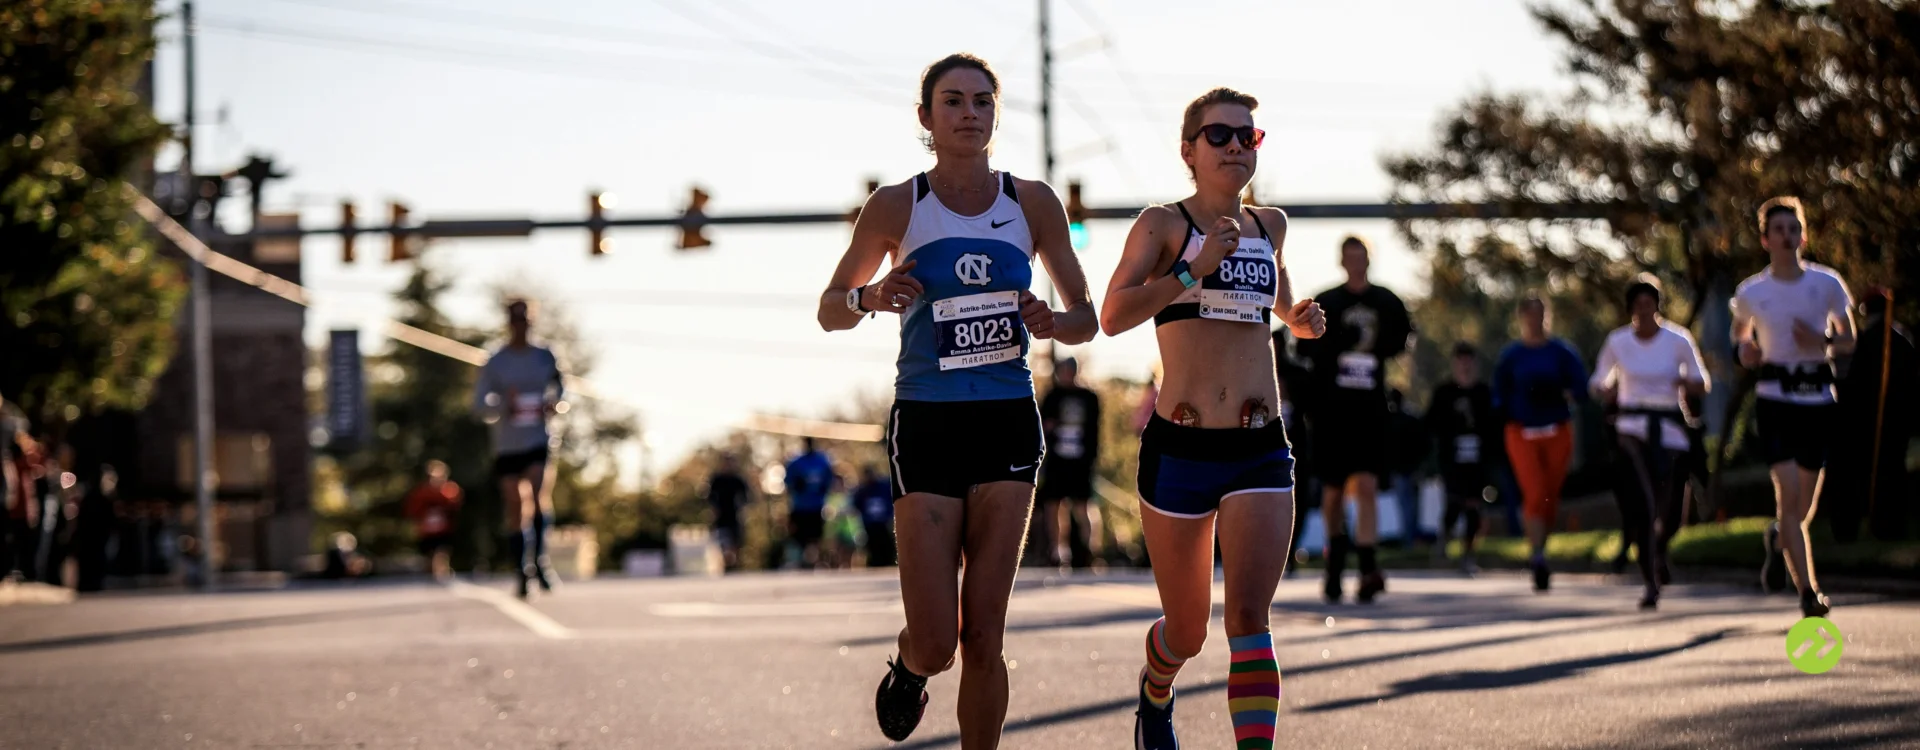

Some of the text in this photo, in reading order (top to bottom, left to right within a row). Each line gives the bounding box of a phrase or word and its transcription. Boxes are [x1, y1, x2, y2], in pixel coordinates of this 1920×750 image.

[1219, 259, 1270, 286] 8499
[1222, 292, 1262, 301] MARATHON
[959, 303, 997, 313] Astrike-Davis,
[954, 317, 1013, 347] 8023
[972, 342, 1012, 353] Astrike-Davis
[961, 352, 1005, 365] MARATHON
